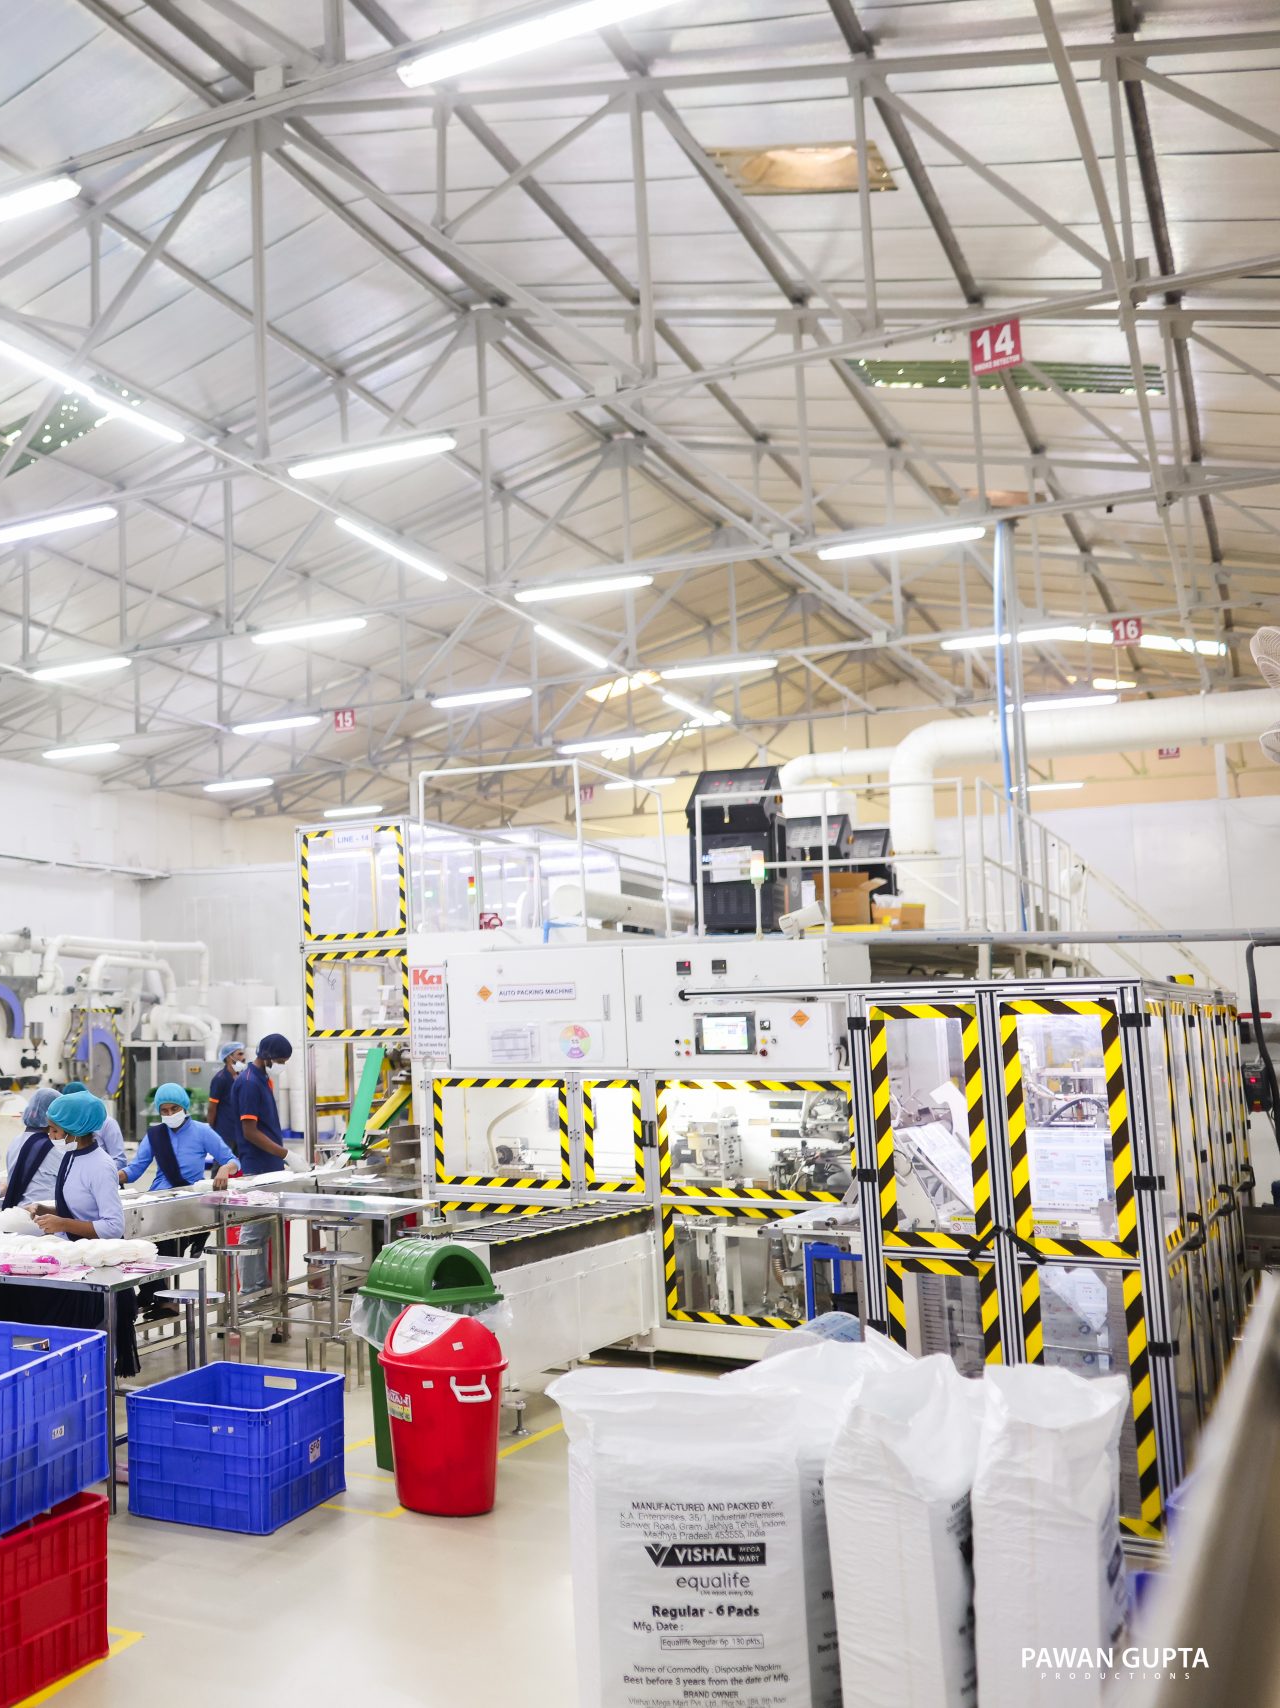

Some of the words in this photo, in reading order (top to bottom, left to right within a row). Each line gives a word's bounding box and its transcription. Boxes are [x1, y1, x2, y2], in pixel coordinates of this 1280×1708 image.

[976, 324, 1015, 362] 14
[1115, 620, 1139, 640] 16
[337, 711, 353, 728] 15
[337, 836, 353, 844] LINE
[632, 1502, 705, 1511] MANUFACTURED
[708, 1503, 725, 1511] AND
[727, 1502, 760, 1511] PACKED
[712, 1513, 748, 1521] Industrial
[679, 1522, 703, 1531] Gram
[643, 1530, 677, 1541] Madhya
[680, 1531, 713, 1540] Pradesh
[747, 1529, 766, 1537] India
[674, 1547, 737, 1565] VISHAL
[739, 1545, 761, 1553] MEGA
[738, 1555, 760, 1563] MART
[676, 1572, 751, 1592] equalife
[652, 1605, 706, 1620] Regular
[716, 1605, 725, 1616] 6
[727, 1605, 760, 1617] Pads
[633, 1621, 654, 1633] Mfg.
[656, 1621, 679, 1631] Date
[693, 1638, 718, 1648] Regular
[633, 1664, 656, 1673] Name
[657, 1665, 665, 1673] of
[666, 1665, 709, 1674] Commodity
[715, 1665, 753, 1675] Disposable
[623, 1675, 643, 1685] Best
[645, 1677, 673, 1685] before
[675, 1677, 681, 1686] 3
[682, 1678, 706, 1687] years
[708, 1677, 728, 1686] from
[730, 1677, 744, 1685] the
[745, 1676, 762, 1685] date
[763, 1675, 772, 1683] of
[683, 1690, 710, 1699] BRAND
[711, 1691, 739, 1699] OWNER
